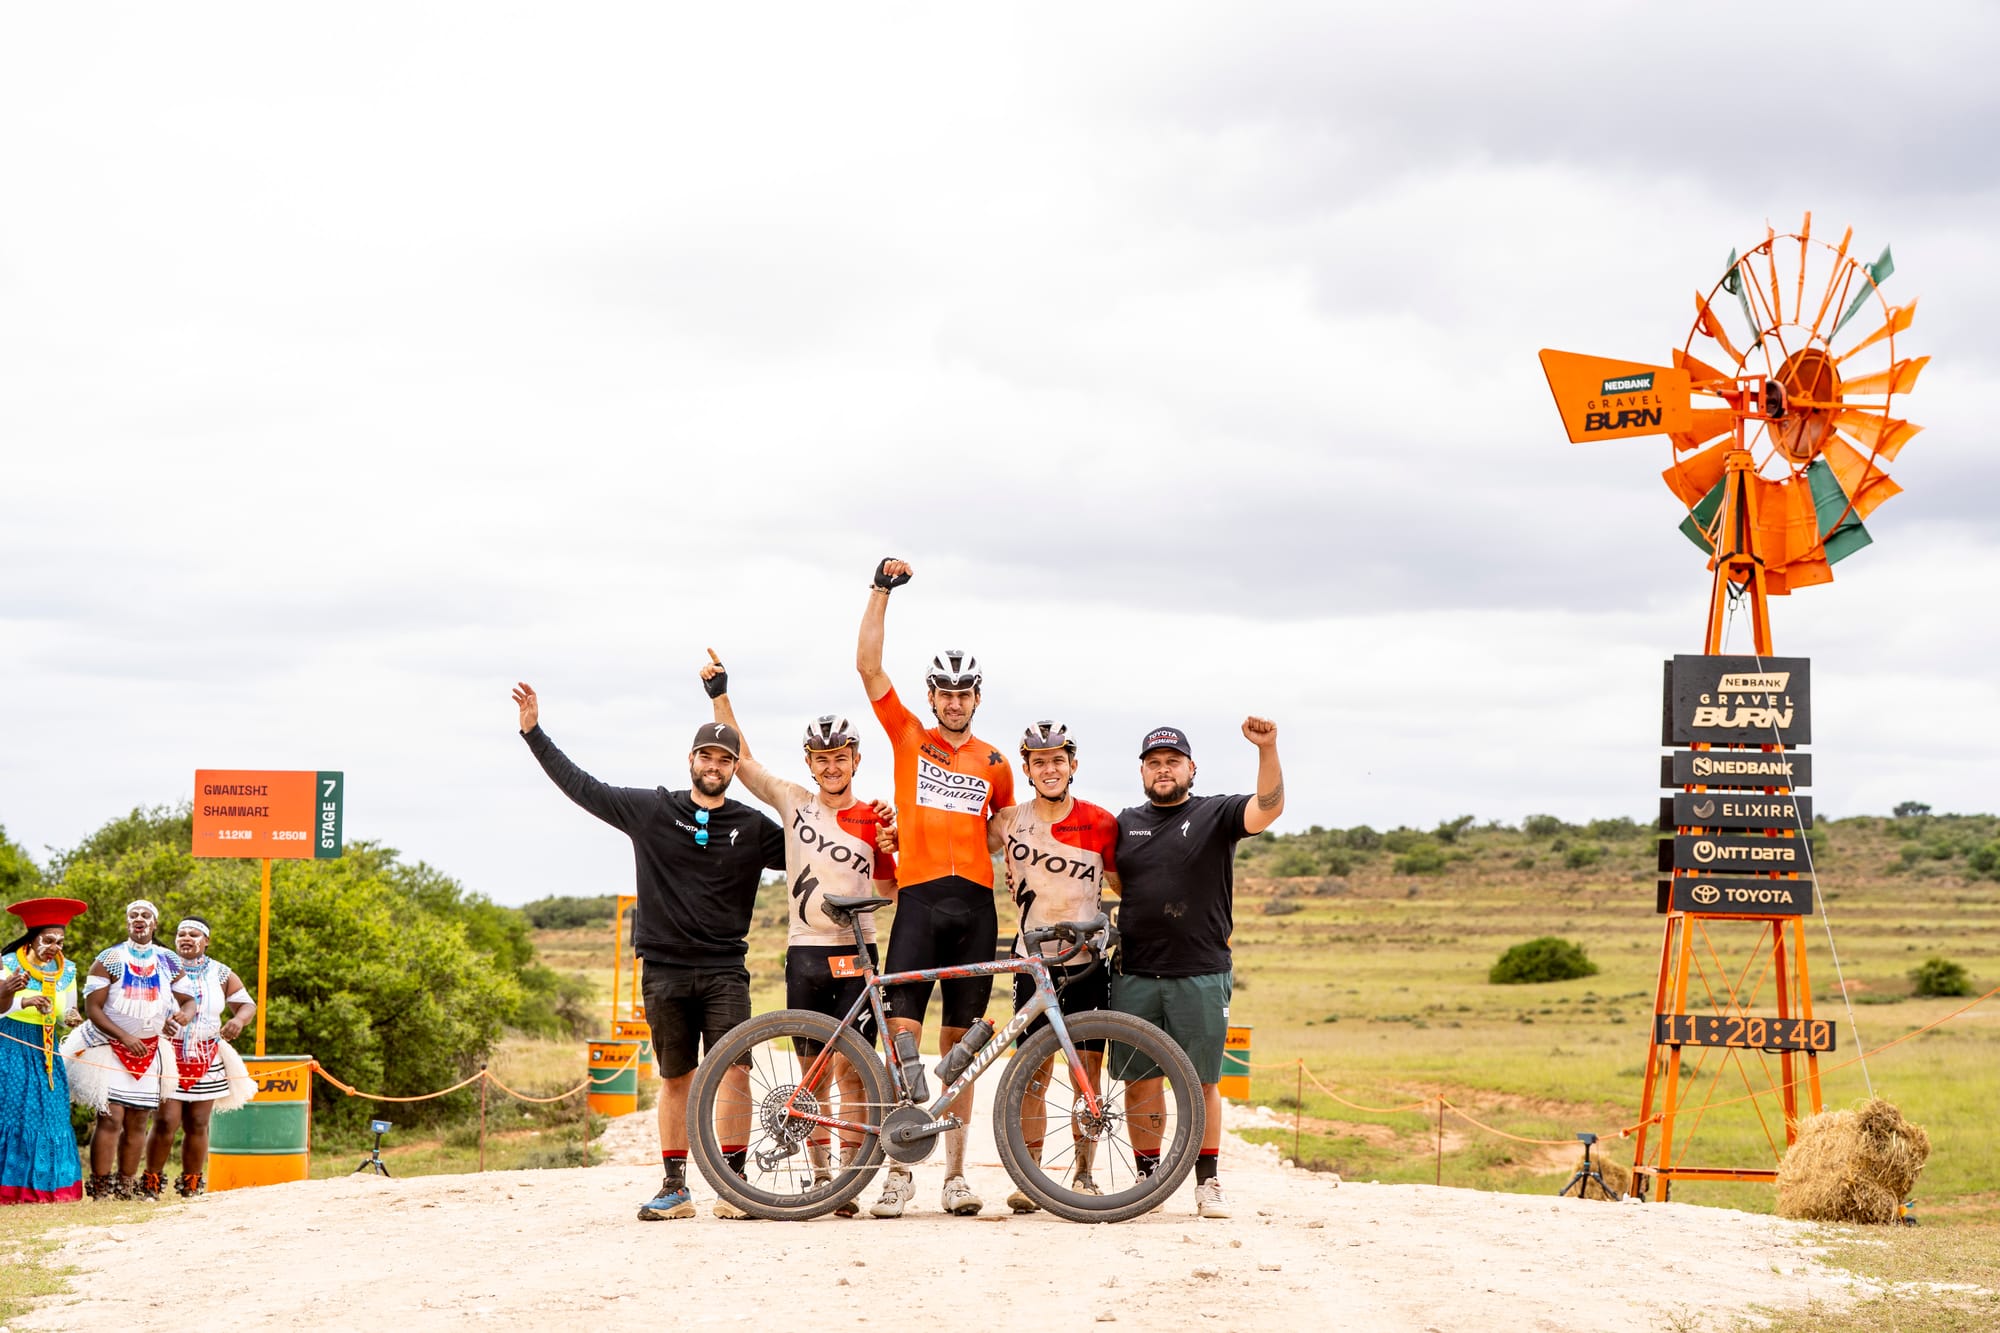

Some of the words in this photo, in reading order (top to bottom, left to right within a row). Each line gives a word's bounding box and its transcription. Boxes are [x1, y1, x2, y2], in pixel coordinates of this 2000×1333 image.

[1604, 379, 1651, 391] NEDBANK
[1587, 394, 1661, 410] GRAVEL
[1584, 407, 1662, 432] BURN
[1725, 678, 1781, 687] NEDBANK
[1700, 693, 1794, 706] GRAVEL
[1692, 706, 1794, 728] BURN
[1149, 730, 1178, 741] TOYOTA
[920, 759, 986, 789] TOYOTA
[1713, 761, 1794, 775] NEDBANK
[204, 784, 268, 796] GWANISHI
[323, 780, 337, 797] 7
[919, 781, 986, 802] SPECIALIZED
[203, 805, 269, 818] SHAMWARI
[1723, 803, 1795, 818] ELIXIRR
[321, 802, 336, 849] STAGE
[218, 830, 253, 840] 112KM
[272, 831, 307, 840] 1250M
[793, 809, 870, 880] TOYOTA
[1008, 834, 1096, 882] TOYOTA
[1717, 846, 1749, 860] NTT
[1725, 888, 1793, 904] TOYOTA
[838, 958, 846, 968] 4
[1664, 1015, 1830, 1050] 11:20:40
[947, 1012, 1029, 1101] S-WORKS
[255, 1080, 298, 1092] URN
